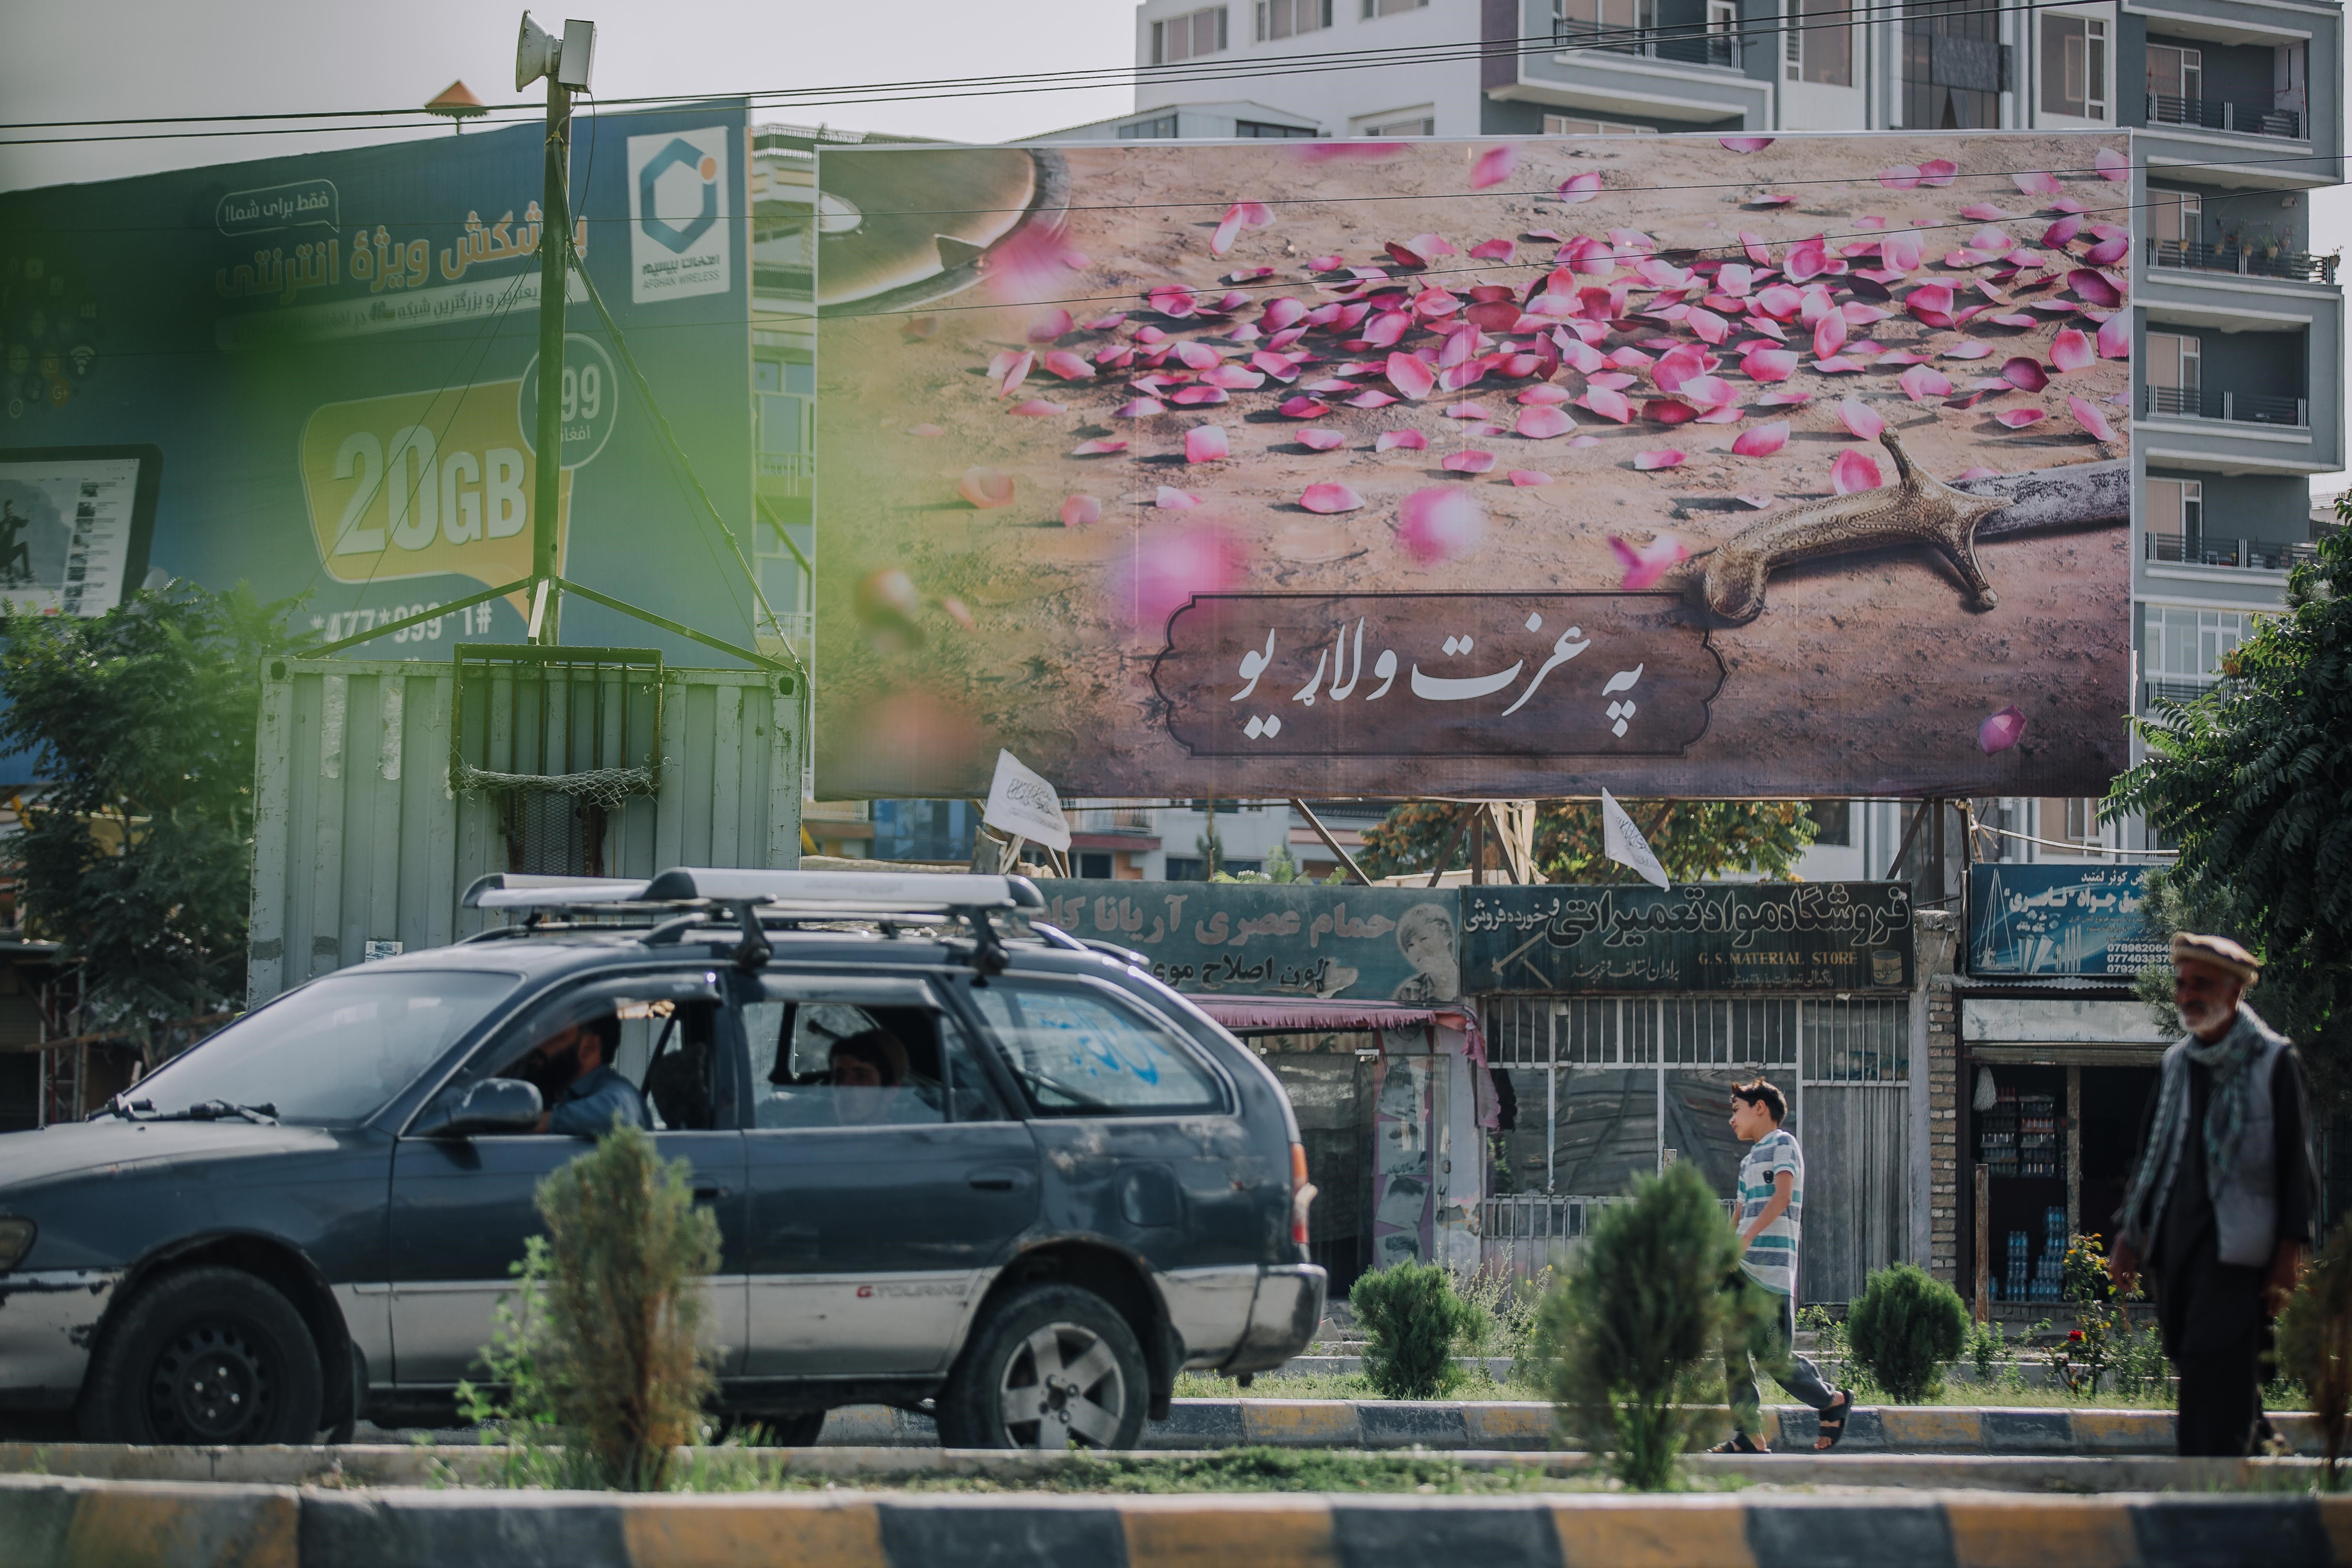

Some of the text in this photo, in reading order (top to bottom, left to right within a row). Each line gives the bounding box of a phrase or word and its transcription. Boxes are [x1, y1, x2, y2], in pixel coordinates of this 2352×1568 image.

[263, 200, 293, 219] برای
[297, 191, 330, 211] فقط
[215, 239, 339, 305] انترنتی
[643, 269, 721, 289] AFGHAN WIRELESS
[535, 365, 600, 422] 99
[334, 425, 528, 556] 20GB
[1229, 626, 1283, 741] یو
[1410, 611, 1592, 717] عزت
[1600, 661, 1645, 739] په
[2107, 869, 2128, 886] کوثر
[1095, 894, 1189, 943] آریانا
[1195, 909, 1300, 947] عصری
[1309, 902, 1396, 949] حمام
[1463, 898, 1507, 933] فروشی
[1545, 887, 1705, 949] تعمیراتی
[1703, 890, 1781, 948] مواد
[1779, 884, 1911, 946] فروشگاه
[1201, 952, 1274, 987] اصلاح
[1812, 951, 1858, 966] STORE
[2107, 943, 2172, 953] 078962064
